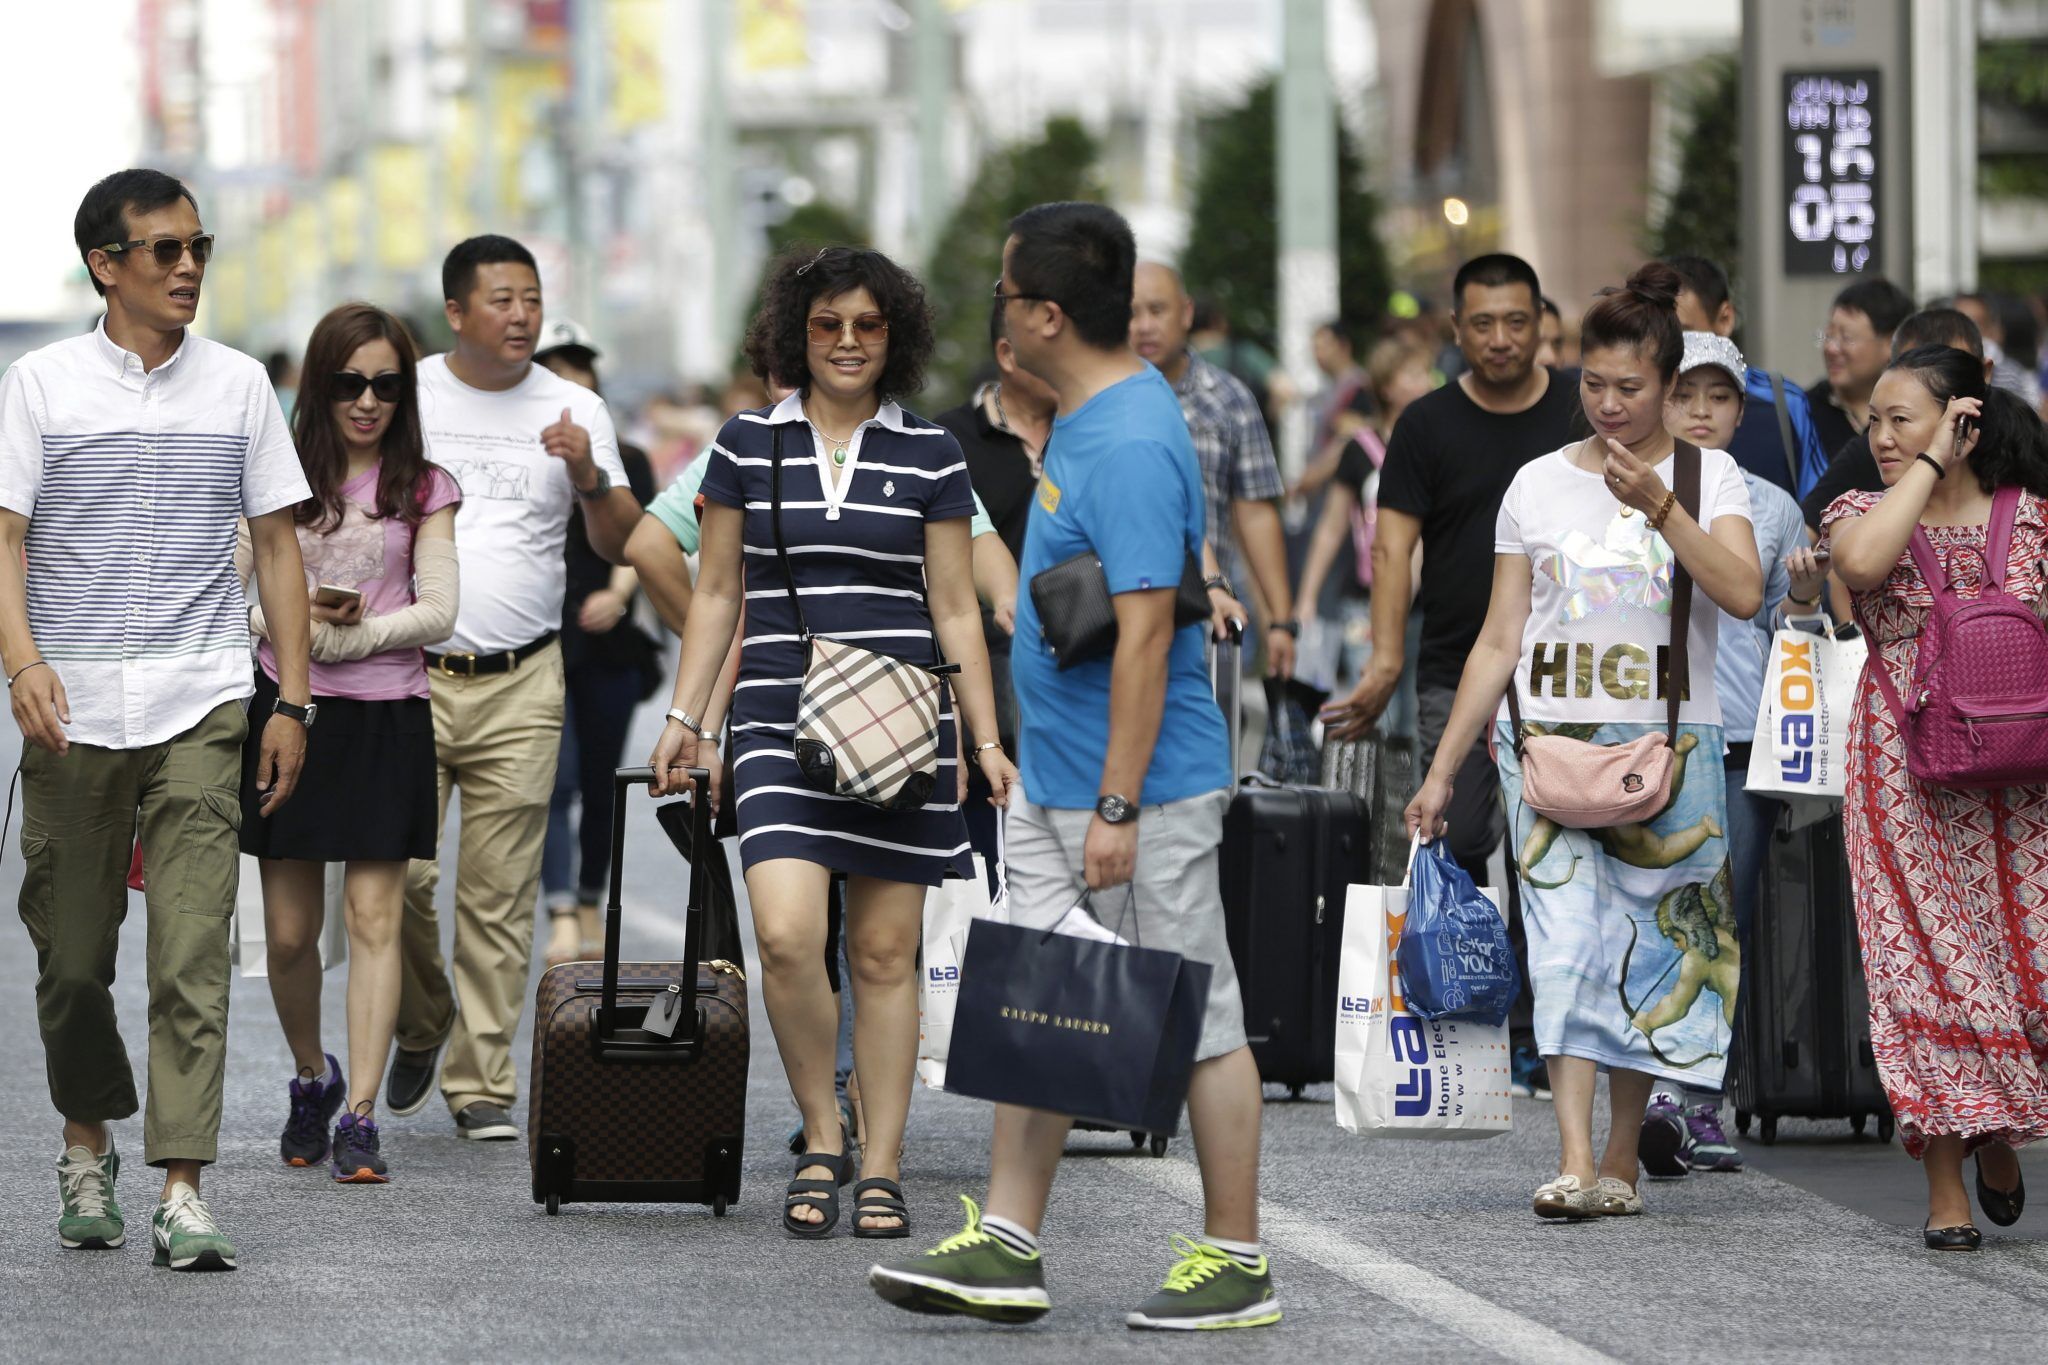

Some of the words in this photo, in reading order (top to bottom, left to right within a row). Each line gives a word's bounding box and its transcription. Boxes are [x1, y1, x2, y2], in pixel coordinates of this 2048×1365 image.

[1813, 642, 1822, 675] Store
[1815, 679, 1830, 745] Electronics
[1817, 749, 1829, 786] Home
[1457, 953, 1495, 973] YOU
[1000, 1006, 1048, 1023] RALPH
[1054, 1015, 1110, 1035] LAUREN
[1449, 1025, 1464, 1116] www.la
[1437, 1065, 1450, 1117] Home
